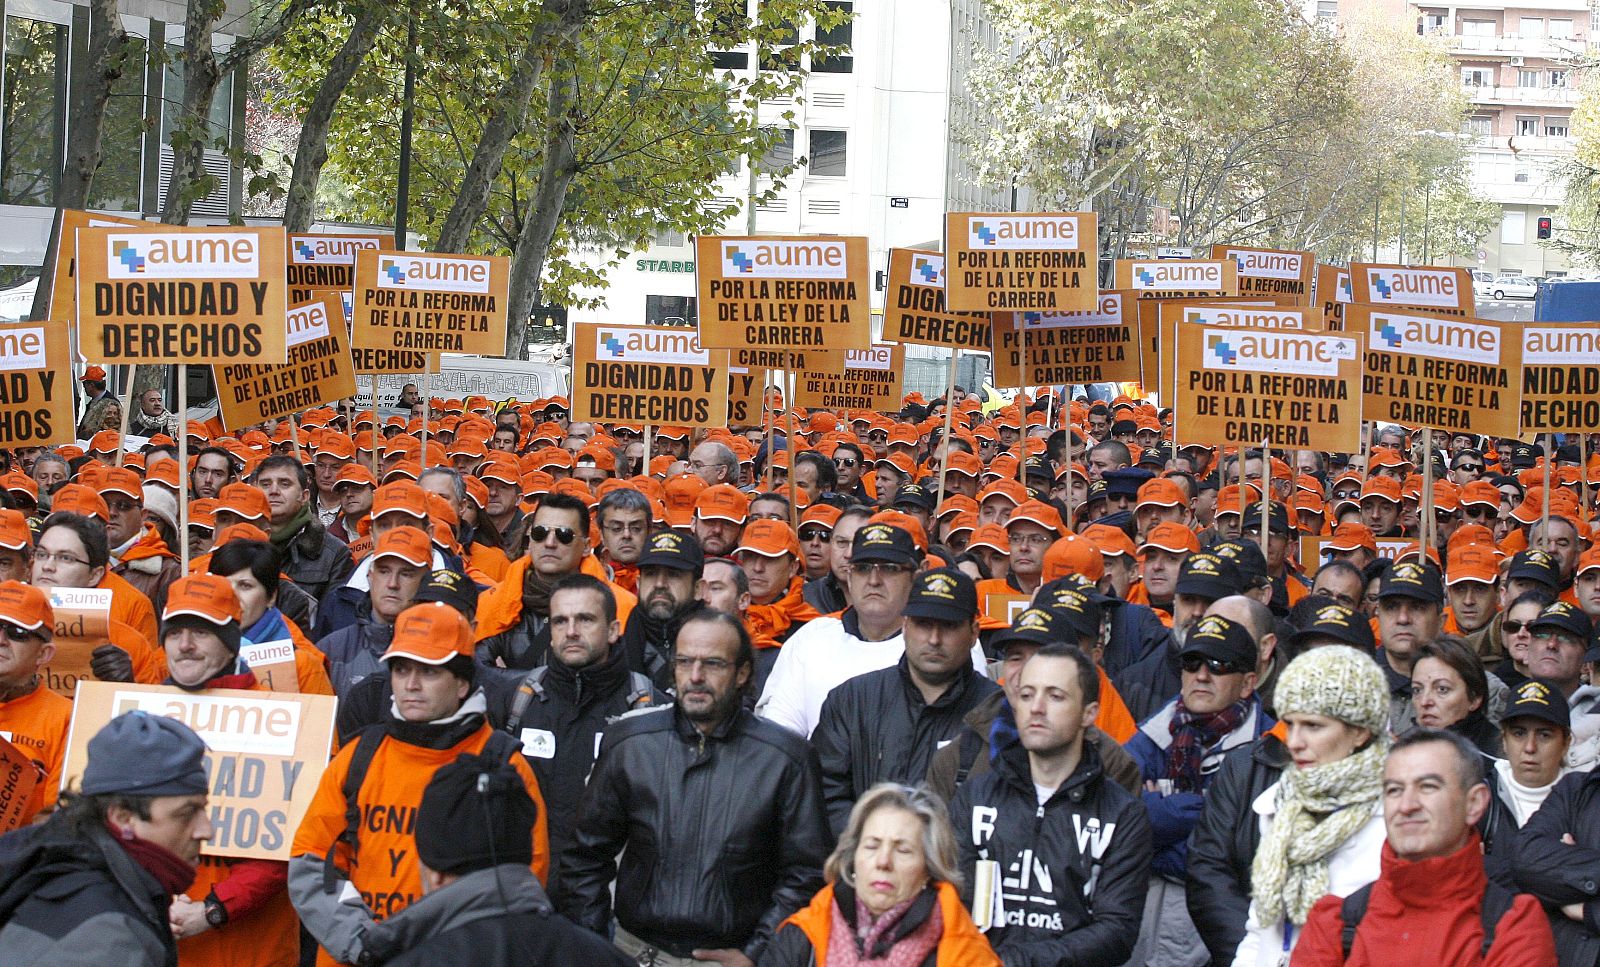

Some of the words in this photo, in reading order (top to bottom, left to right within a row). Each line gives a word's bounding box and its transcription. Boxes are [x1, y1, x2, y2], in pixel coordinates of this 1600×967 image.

[997, 221, 1075, 239] aume
[148, 238, 253, 264] aume
[755, 243, 842, 267] aume
[958, 252, 986, 268] POR
[992, 252, 1009, 268] LA
[1015, 252, 1086, 268] REFORMA
[1246, 253, 1298, 271] aume
[408, 260, 486, 282] aume
[964, 272, 981, 288] DE
[987, 272, 1003, 288] LA
[1009, 272, 1034, 288] LEY
[1040, 272, 1057, 288] DE
[1062, 272, 1080, 288] LA
[1156, 265, 1218, 282] aume
[711, 280, 744, 299] POR
[750, 281, 769, 299] LA
[775, 280, 857, 301] REFORMA
[1255, 279, 1304, 295] REFORMA
[1392, 274, 1454, 296] aume
[95, 282, 238, 317] DIGNIDAD
[249, 282, 269, 316] Y
[365, 289, 395, 308] POR
[400, 290, 418, 308] LA
[424, 292, 496, 313] REFORMA
[988, 291, 1056, 308] CARRERA
[371, 309, 388, 327] DE
[393, 310, 411, 328] LA
[416, 312, 443, 330] LEY
[448, 313, 466, 331] DE
[470, 314, 488, 332] LA
[719, 303, 738, 322] DE
[743, 303, 763, 322] LA
[770, 303, 798, 322] LEY
[804, 303, 825, 323] DE
[830, 303, 850, 323] LA
[103, 324, 262, 358] DERECHOS
[393, 331, 463, 351] CARRERA
[627, 332, 705, 354] aume
[746, 326, 824, 346] CARRERA
[1038, 330, 1056, 346] LA
[1060, 327, 1130, 344] REFORMA
[1404, 321, 1496, 352] aume
[1526, 330, 1600, 352] aum
[276, 337, 340, 371] EFORMA
[1033, 349, 1050, 365] LA
[1055, 347, 1080, 364] LEY
[1085, 346, 1103, 362] DE
[1107, 345, 1125, 361] LA
[233, 385, 252, 404] DE
[254, 379, 271, 398] LA
[273, 370, 298, 393] LEY
[301, 364, 318, 383] DE
[321, 359, 338, 378] LA
[585, 362, 696, 391] DIGNIDAD
[702, 367, 716, 392] Y
[844, 369, 895, 383] REFORMA
[1034, 365, 1102, 384] CARRERA
[1397, 356, 1417, 377] LA
[1424, 359, 1508, 388] REFORMA
[38, 371, 55, 401] Y
[807, 381, 820, 393] DE
[823, 382, 836, 394] LA
[838, 382, 858, 395] LEY
[861, 384, 874, 396] DE
[877, 385, 890, 397] LA
[1189, 371, 1226, 392] POR
[1232, 373, 1254, 394] LA
[1260, 374, 1348, 400] REFORMA
[1363, 376, 1384, 396] DE
[1389, 378, 1410, 399] LA
[1416, 381, 1446, 402] LEY
[1452, 386, 1473, 407] DE
[1479, 390, 1500, 410] LA
[260, 386, 321, 418] CARRERA
[590, 393, 709, 422] DERECHOS
[823, 395, 872, 409] CARRERA
[1197, 395, 1218, 416] DE
[1224, 397, 1246, 417] LA
[1252, 398, 1284, 420] LEY
[1290, 401, 1312, 421] DE
[1317, 404, 1339, 424] LA
[1389, 401, 1471, 429] CARRERA
[1226, 421, 1309, 446] CARRERA
[65, 592, 108, 605] aume
[249, 645, 291, 661] aume
[281, 760, 305, 801] Y
[389, 849, 406, 877] Y
